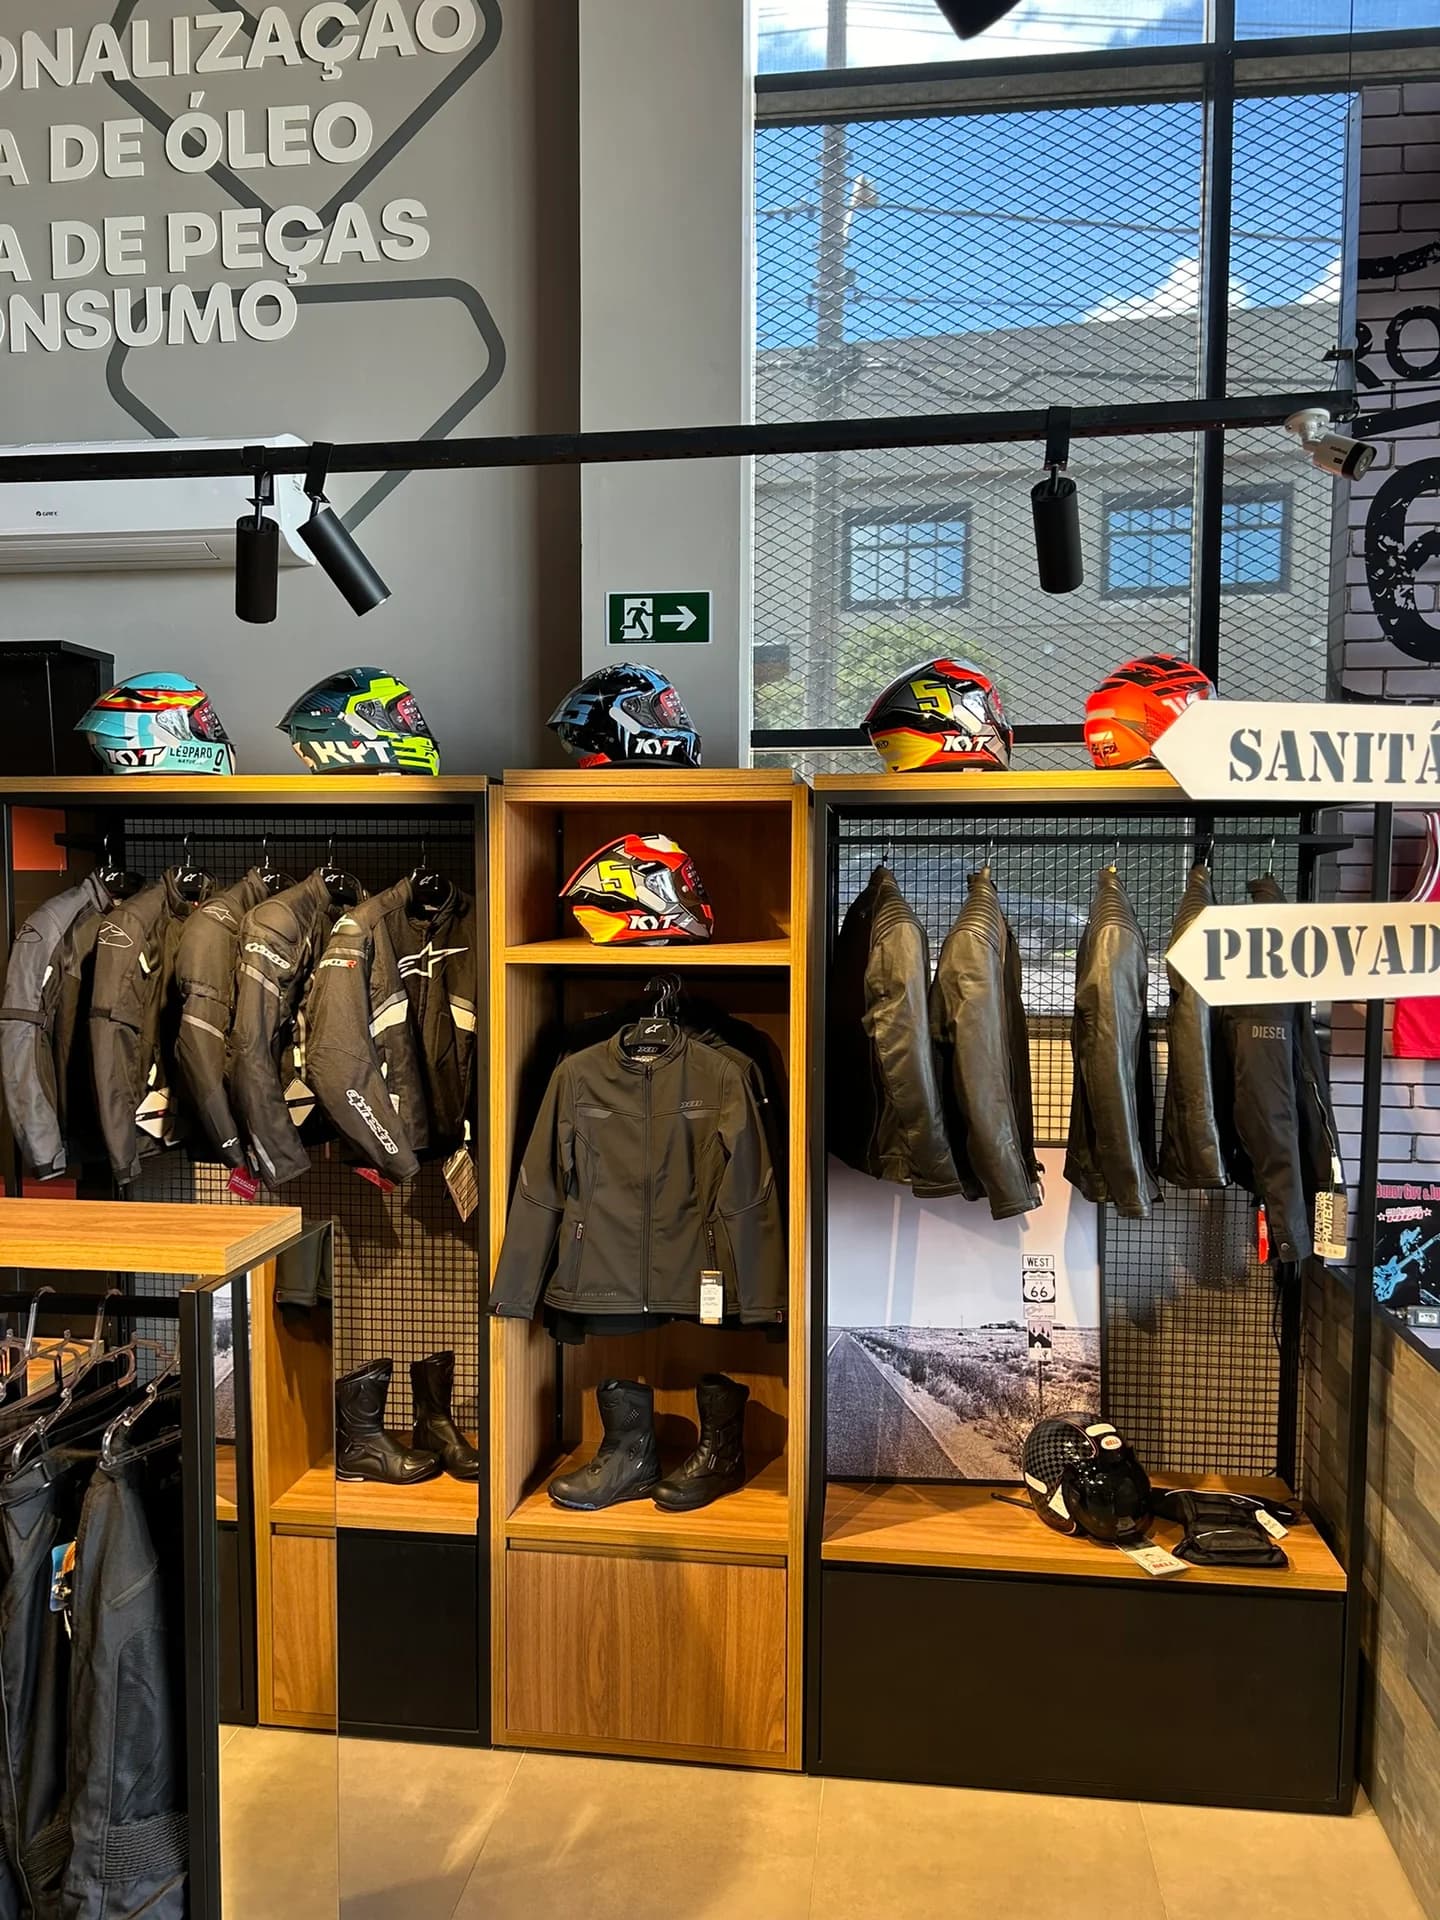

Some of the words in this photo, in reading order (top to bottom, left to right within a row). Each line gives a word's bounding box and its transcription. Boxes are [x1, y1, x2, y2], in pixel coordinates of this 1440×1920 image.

[50, 118, 145, 183] DE
[165, 90, 374, 173] ÓLEO
[50, 216, 147, 280] DE
[167, 198, 431, 284] PEÇAS
[0, 279, 298, 353] NSUMO
[634, 738, 682, 756] KYT
[943, 734, 994, 751] KYT
[105, 748, 164, 767] KYT
[169, 745, 213, 759] LEOPARD
[308, 740, 391, 764] KYT
[628, 914, 681, 930] KYT
[1203, 924, 1440, 981] PROVAD
[1251, 1025, 1287, 1040] DIESEL
[1026, 1257, 1049, 1267] WEST
[1030, 1286, 1048, 1298] 66
